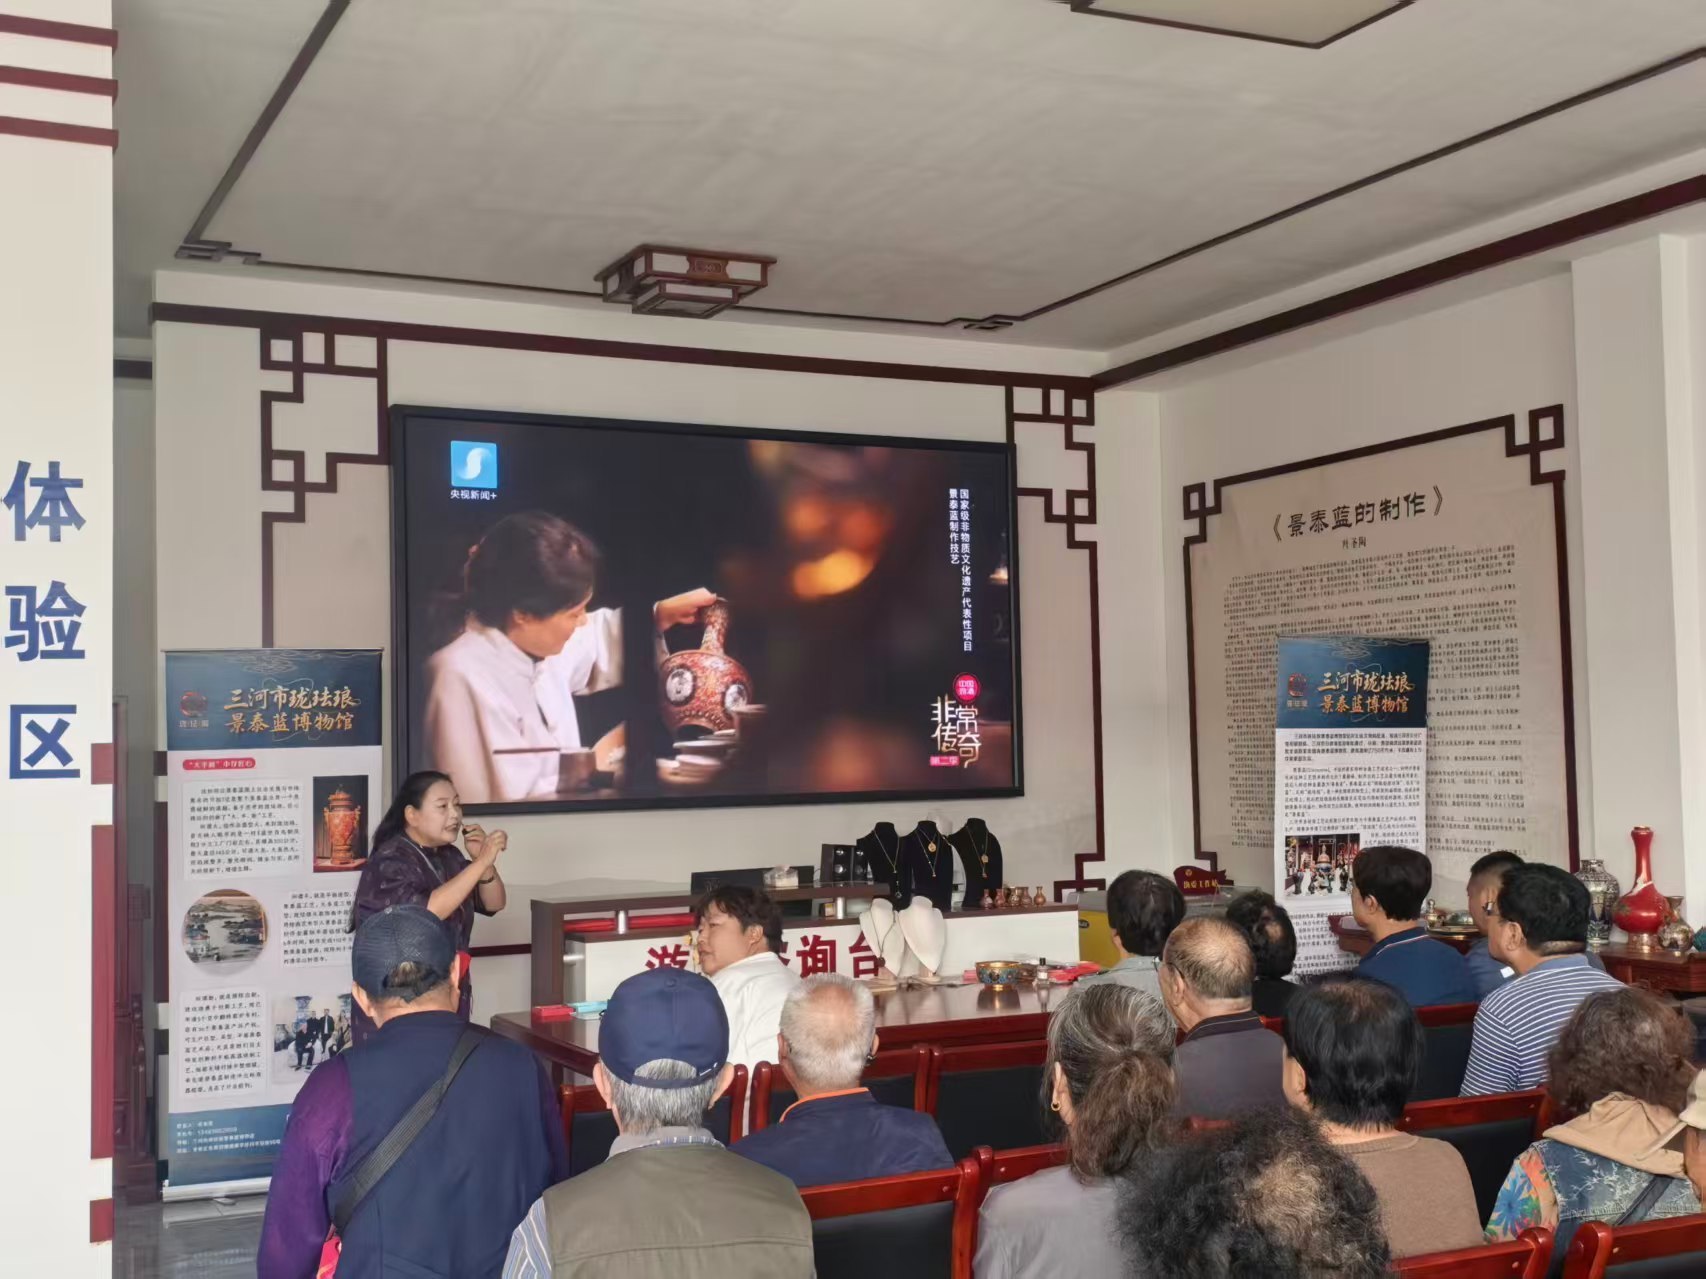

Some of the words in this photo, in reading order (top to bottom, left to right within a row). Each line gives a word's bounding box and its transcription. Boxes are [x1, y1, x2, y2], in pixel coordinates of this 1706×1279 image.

[450, 489, 497, 500] 央视新闻+
[1273, 485, 1443, 541] 《景泰蓝的制作》
[949, 488, 960, 565] 景泰蓝制作技艺
[959, 488, 972, 652] 国家级非物质文化遗产代表性项目
[1, 460, 87, 779] 体验区
[1317, 669, 1411, 693] 三河市珑珐琅
[224, 685, 357, 711] 三河市珑珐琅
[1320, 694, 1409, 714] 景泰蓝博物馆
[225, 710, 354, 733] 景泰蓝博物馆
